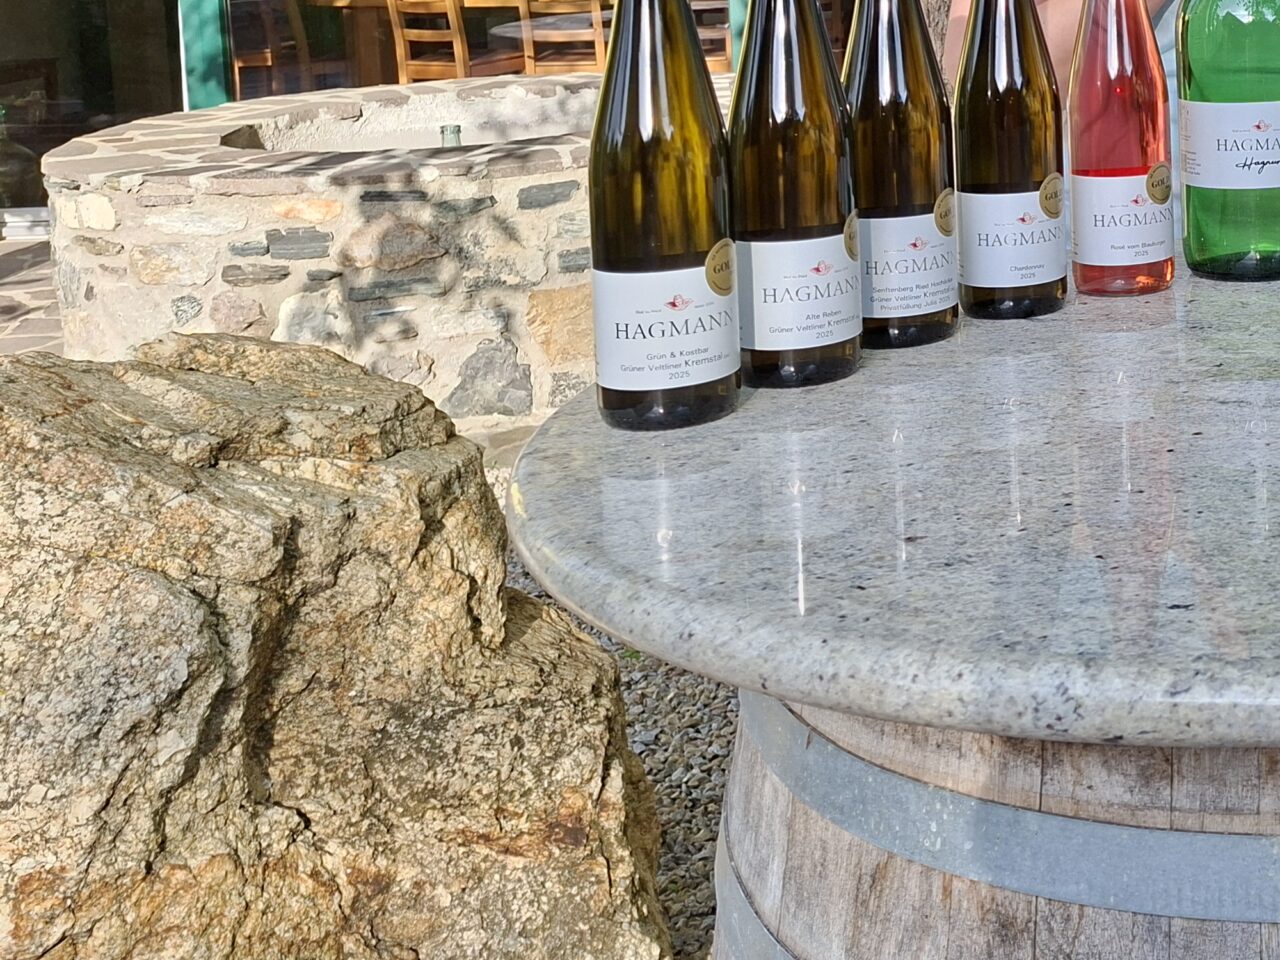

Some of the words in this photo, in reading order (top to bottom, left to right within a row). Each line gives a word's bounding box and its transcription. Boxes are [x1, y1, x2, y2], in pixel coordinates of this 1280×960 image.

[805, 312, 821, 321] Alte
[614, 307, 734, 340] HAGMANN
[769, 326, 793, 334] Grüner
[796, 322, 826, 332] Veltliner
[815, 330, 834, 339] 2025
[646, 351, 667, 361] Grün
[669, 351, 677, 359] &
[679, 346, 709, 357] Kostbar
[620, 363, 645, 372] Grüner
[648, 362, 682, 372] Veltliner
[684, 352, 723, 368] Kremstal
[668, 371, 691, 380] 2025
